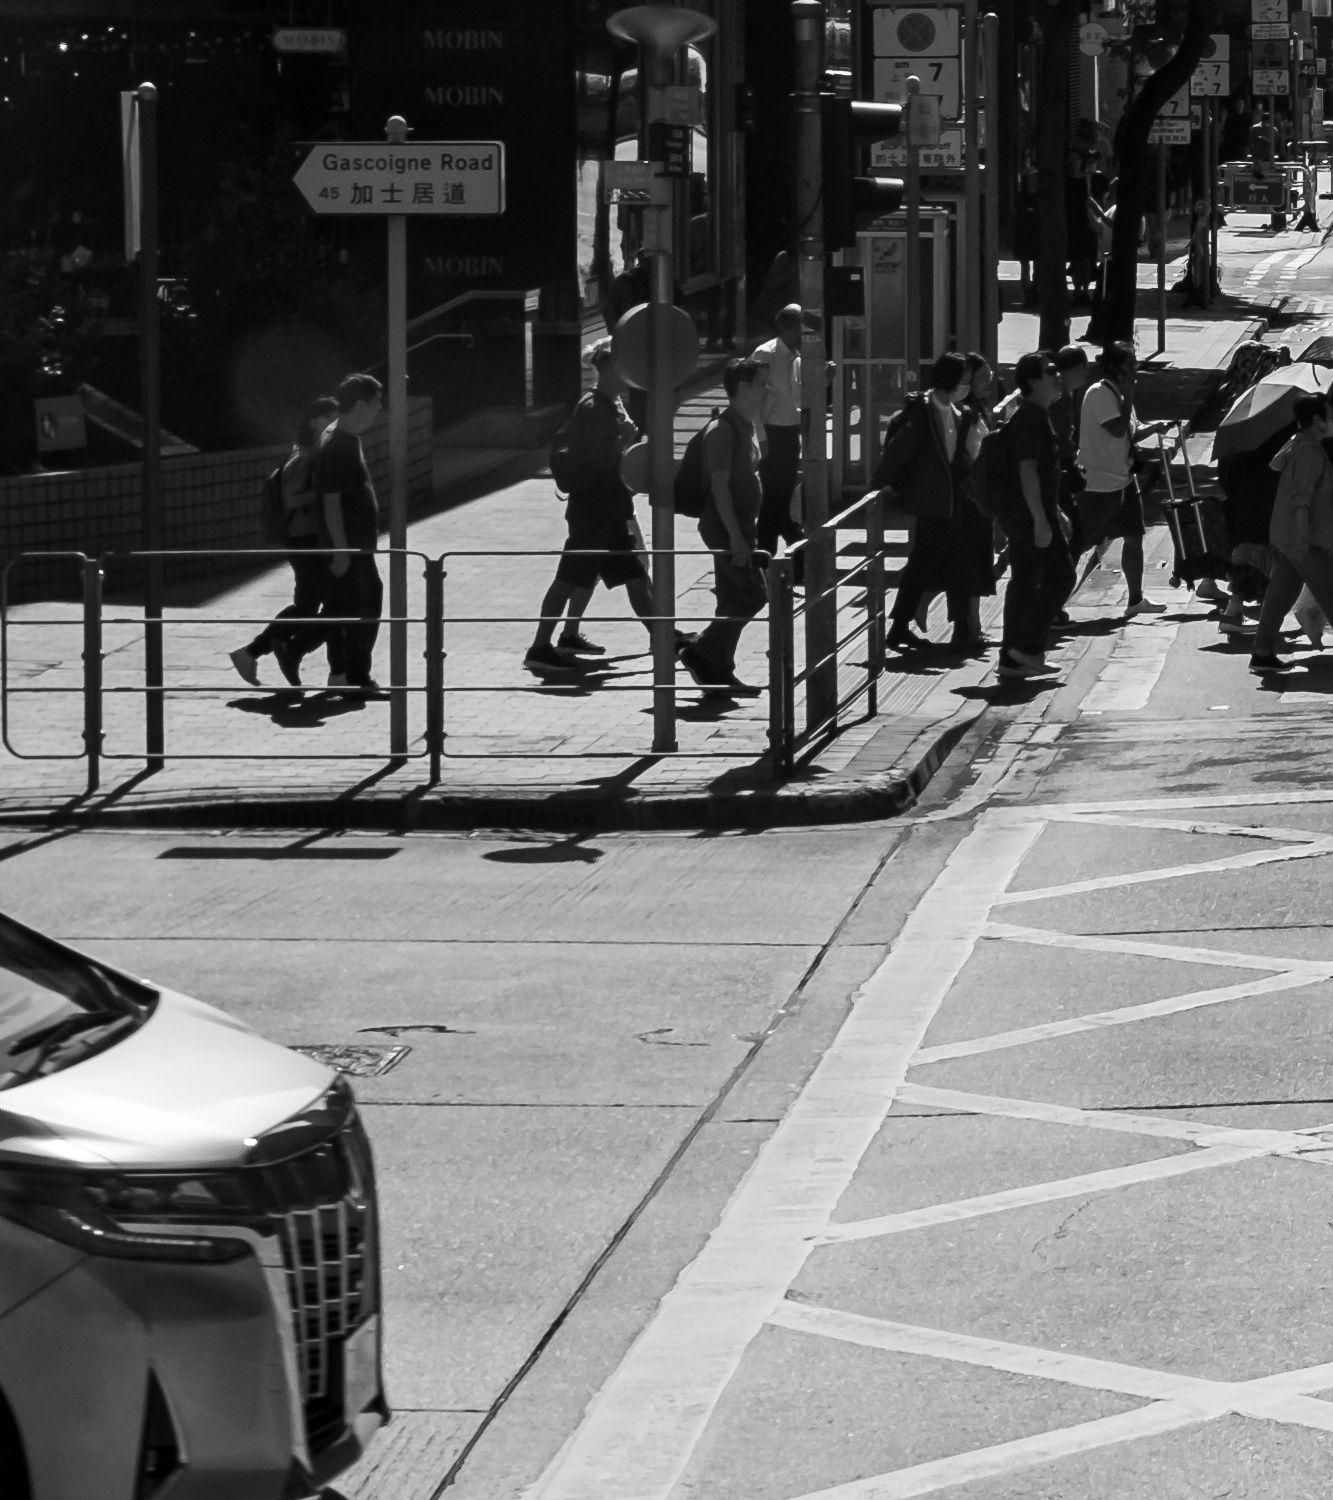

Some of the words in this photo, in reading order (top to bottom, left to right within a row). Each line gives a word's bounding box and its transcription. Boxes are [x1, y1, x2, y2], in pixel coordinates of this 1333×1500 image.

[424, 29, 504, 50] MOBIN
[929, 62, 943, 82] 7
[1212, 65, 1221, 77] 7
[424, 86, 505, 106] MOBIN
[1212, 83, 1221, 95] 7
[1169, 100, 1179, 114] 7
[322, 153, 433, 175] Gascoigne
[440, 153, 494, 172] Road
[318, 186, 341, 200] 45
[350, 181, 467, 205] 加士居道
[424, 255, 505, 276] MOBIN
